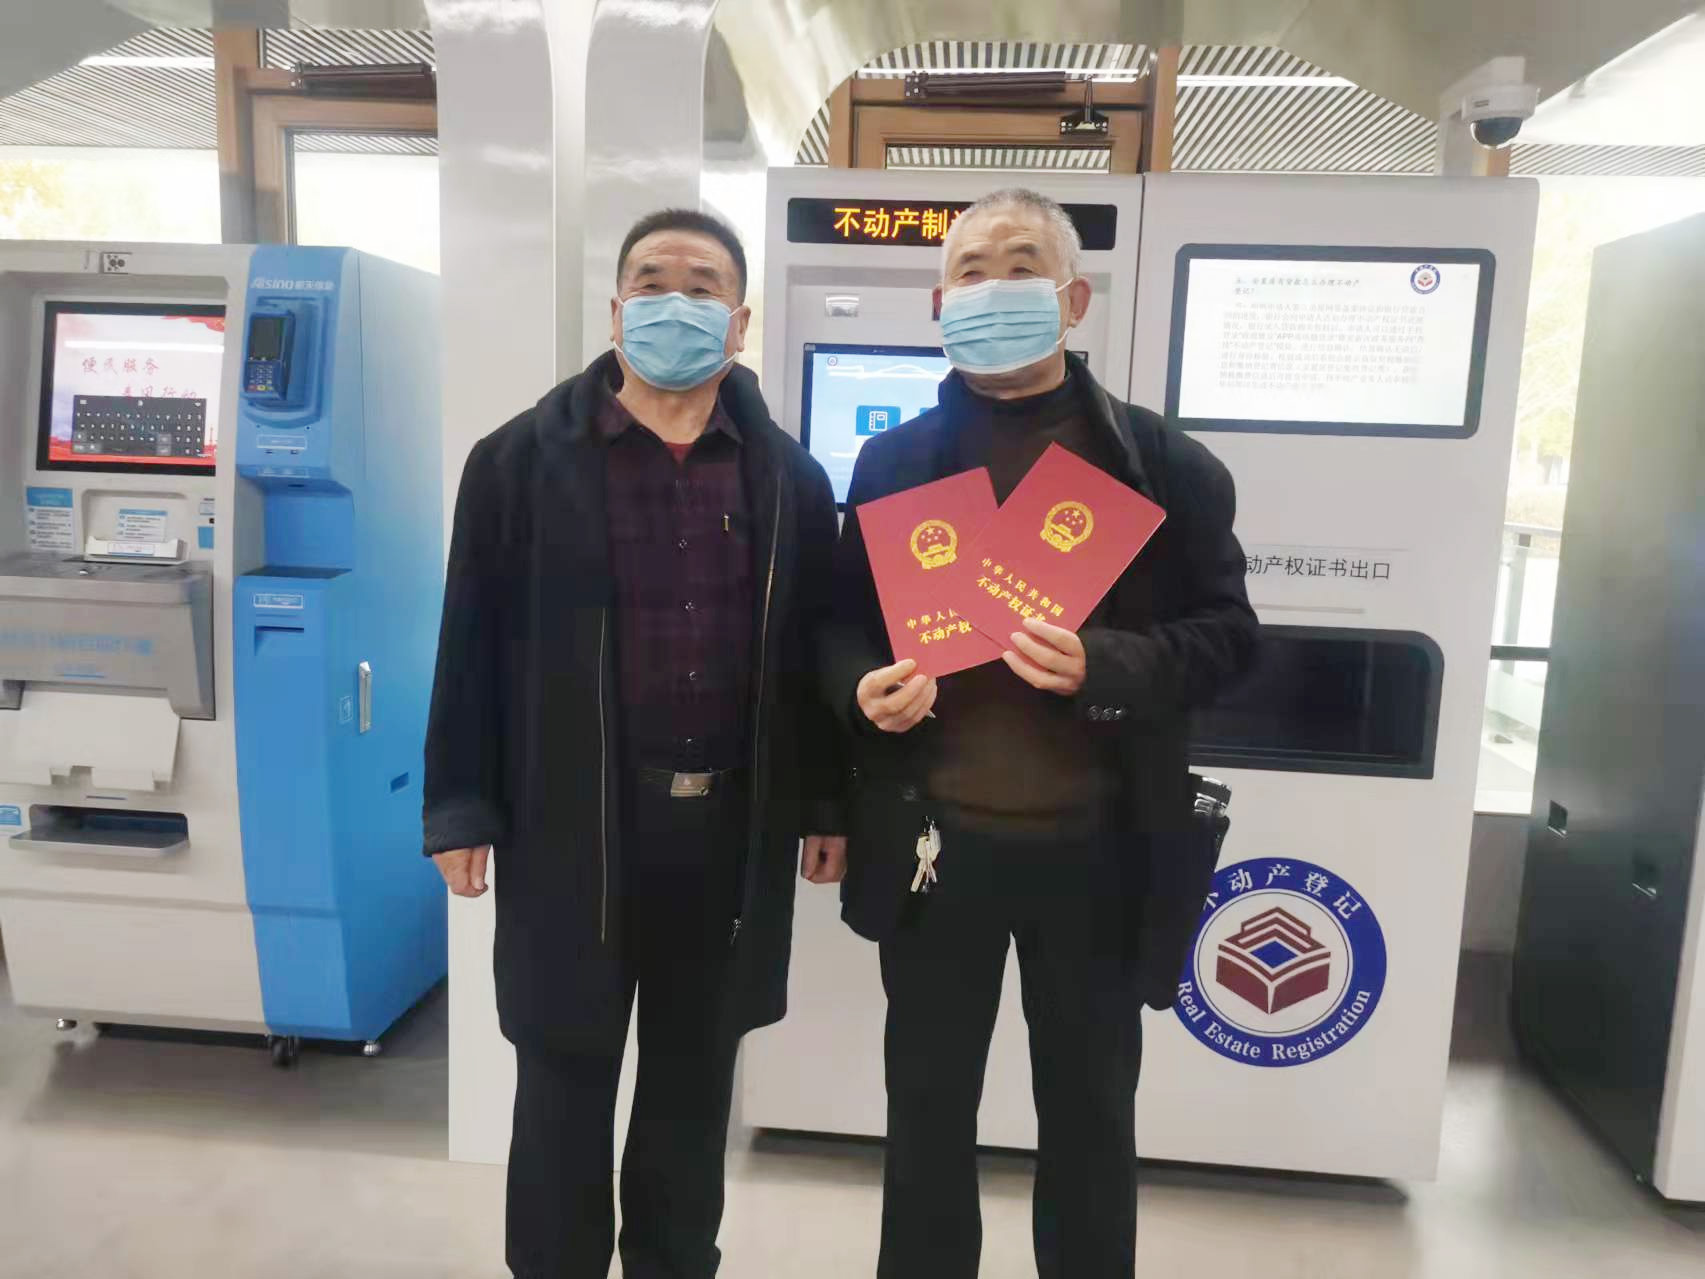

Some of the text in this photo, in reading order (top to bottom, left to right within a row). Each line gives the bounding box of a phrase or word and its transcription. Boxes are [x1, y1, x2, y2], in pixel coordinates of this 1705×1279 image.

[834, 208, 961, 239] 不动产制
[82, 356, 159, 375] 便民服务
[1244, 554, 1391, 580] 动产权证书出口
[981, 557, 1065, 617] 中华人民共和国
[919, 620, 973, 645] 不动产权
[1177, 980, 1371, 1060] Real Estate Registration
